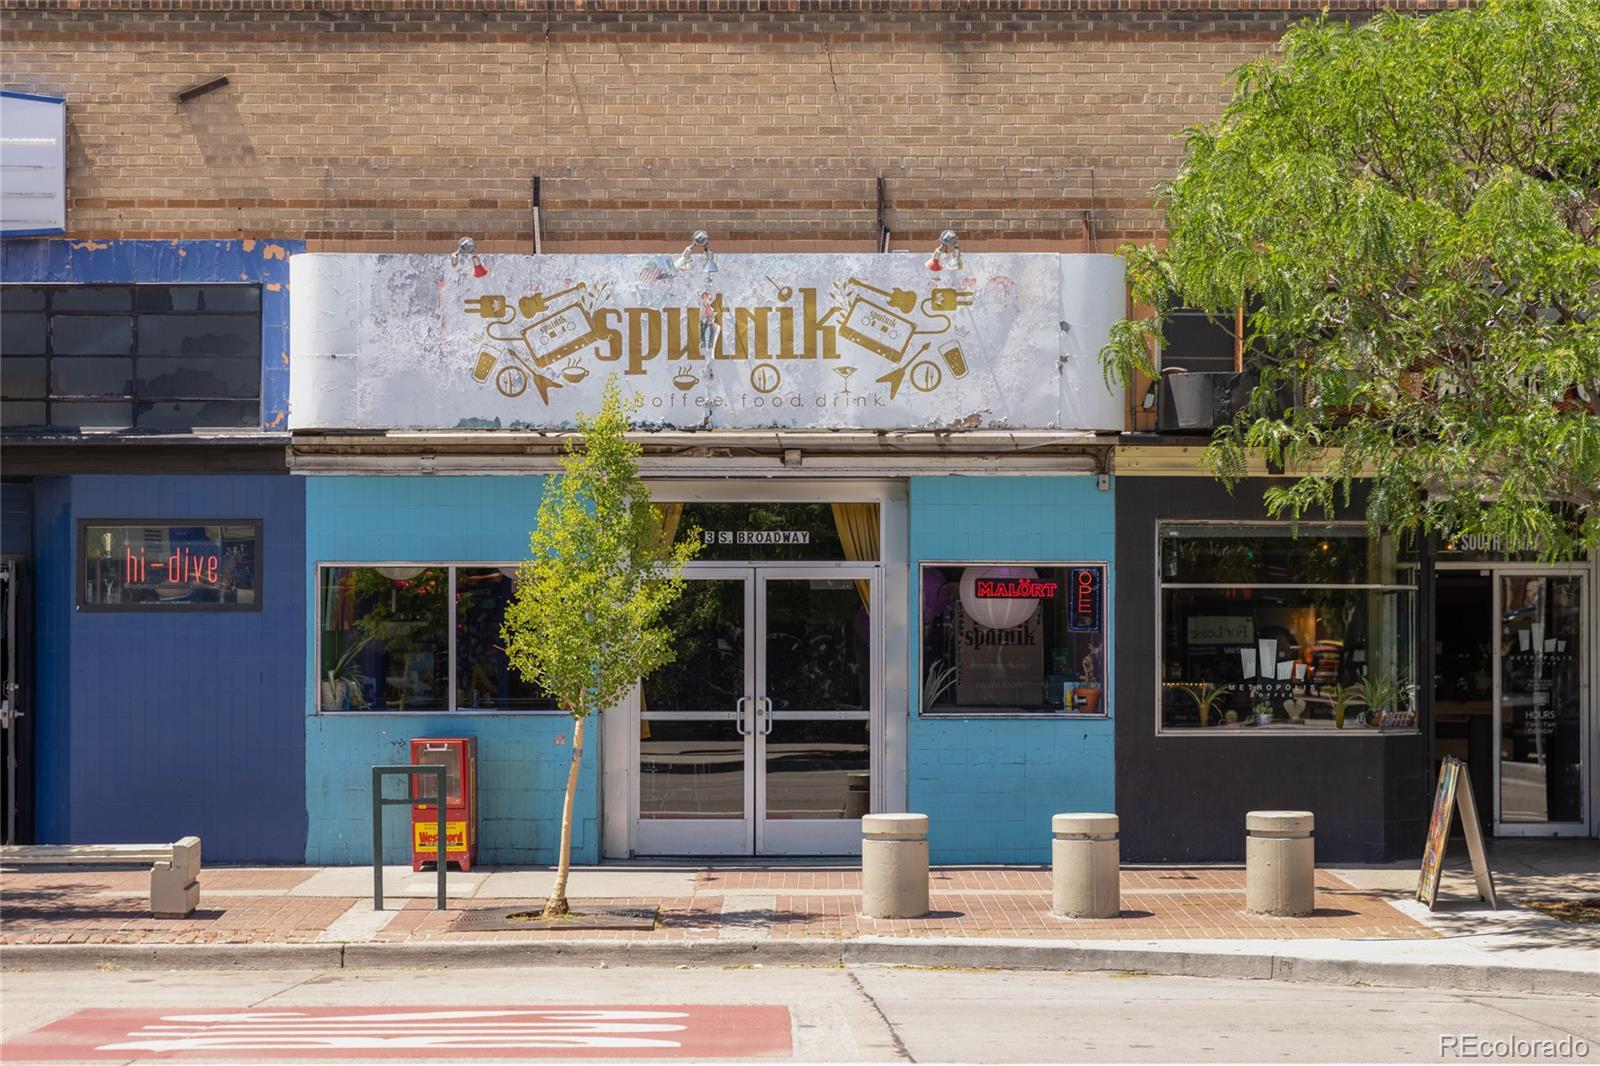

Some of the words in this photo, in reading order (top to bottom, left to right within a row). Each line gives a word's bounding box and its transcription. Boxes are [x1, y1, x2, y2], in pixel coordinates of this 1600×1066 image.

[594, 288, 841, 375] sputnik
[741, 393, 805, 407] food.
[719, 531, 732, 544] S.
[738, 531, 809, 544] BROADWAY
[126, 545, 219, 584] hi-dive
[976, 579, 1058, 598] MALÖRT
[1078, 571, 1093, 623] OPE
[1228, 683, 1316, 692] METROPOLIS
[418, 831, 463, 843] Wesord
